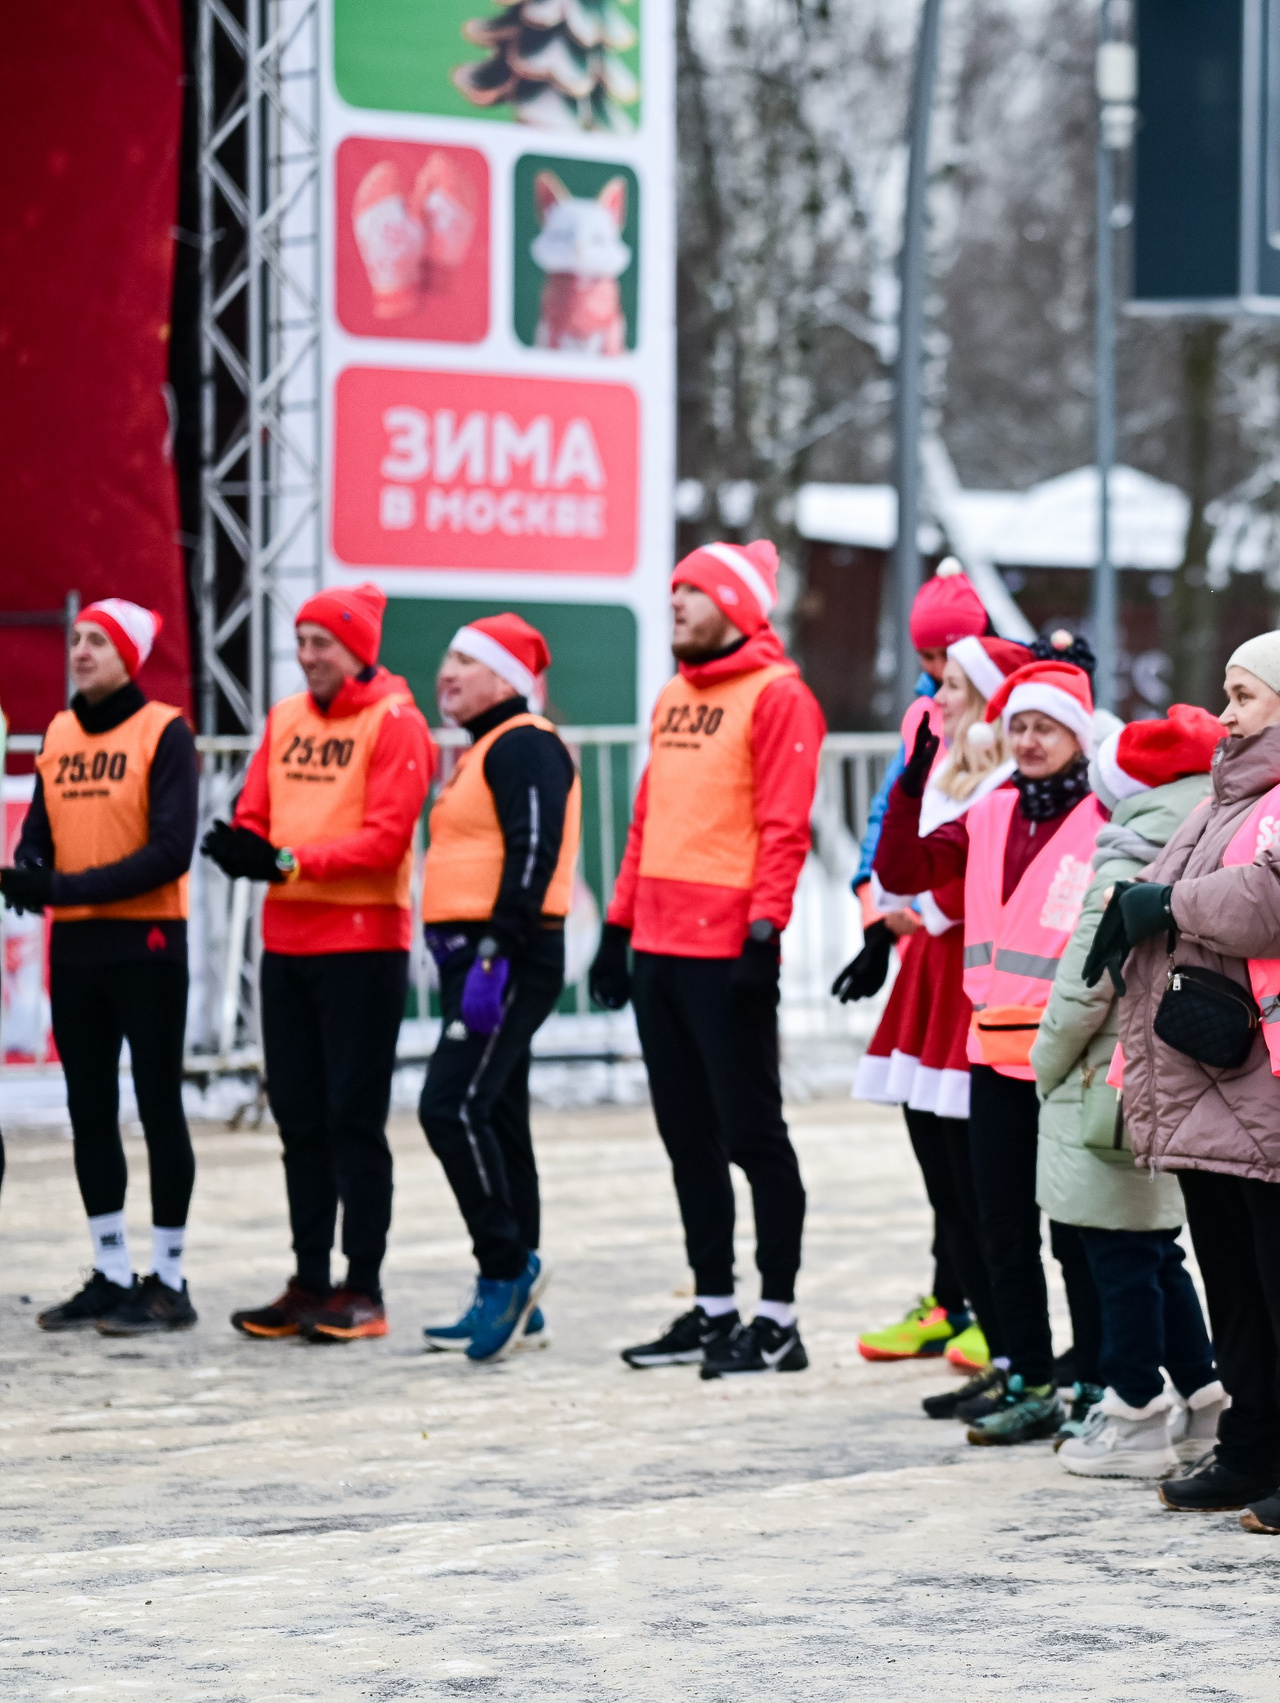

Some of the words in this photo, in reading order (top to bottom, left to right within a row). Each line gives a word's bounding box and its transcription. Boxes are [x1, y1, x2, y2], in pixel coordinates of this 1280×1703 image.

[381, 406, 607, 489] ЗИМА
[380, 486, 415, 531] В
[426, 487, 607, 540] МОСКВЕ
